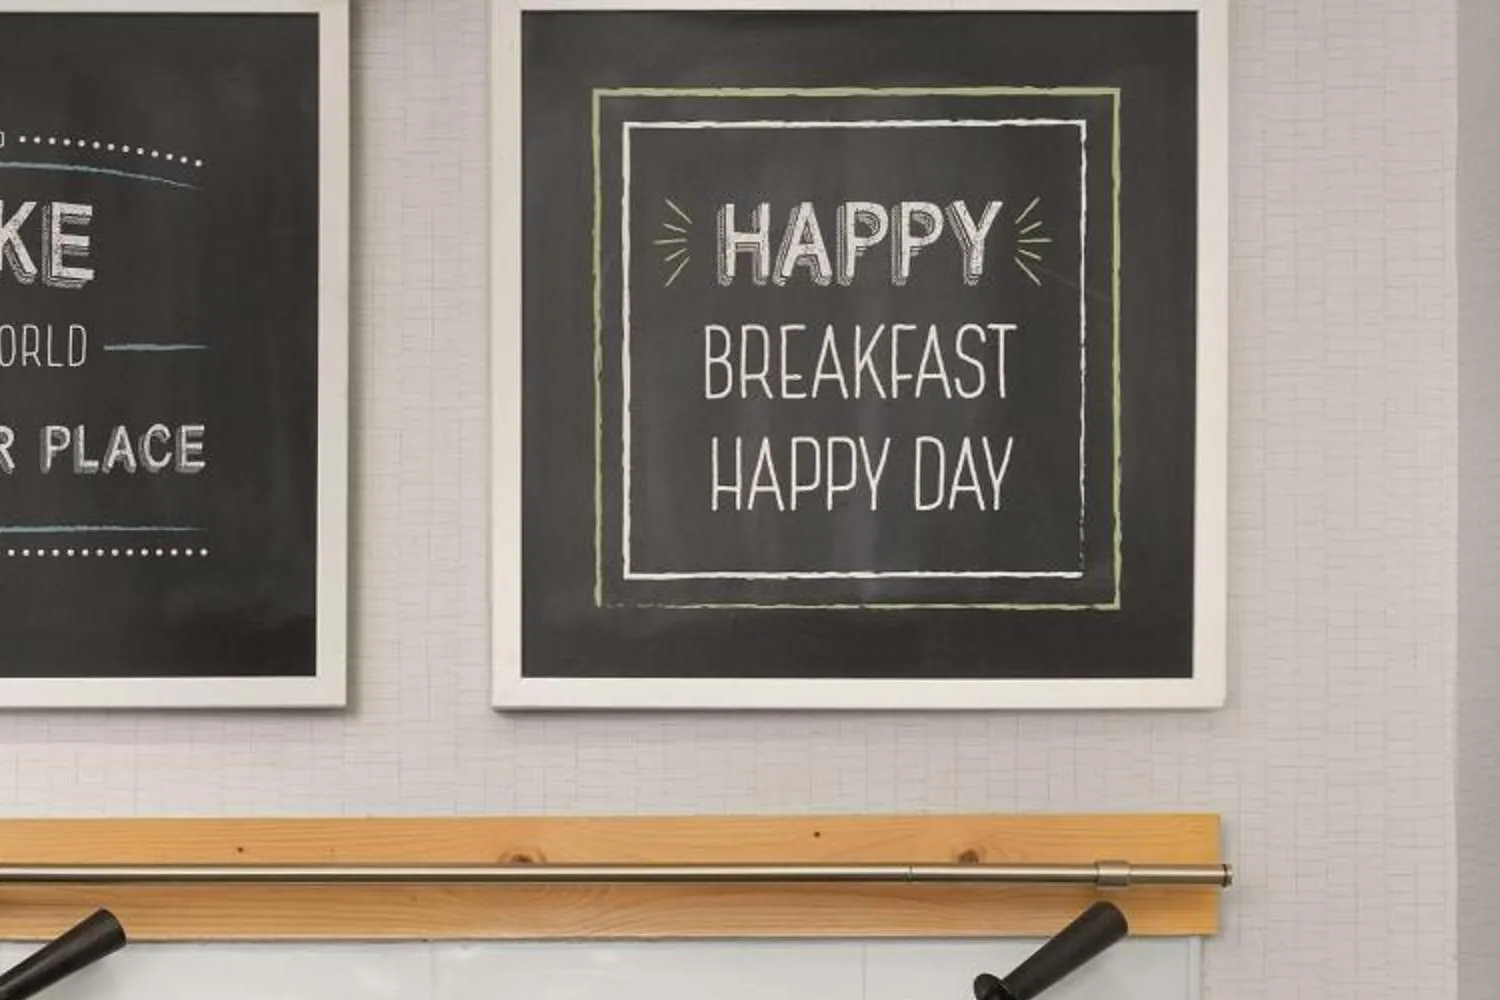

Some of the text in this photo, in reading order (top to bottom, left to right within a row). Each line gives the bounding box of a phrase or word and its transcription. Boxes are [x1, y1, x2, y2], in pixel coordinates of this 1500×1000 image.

[717, 200, 1003, 287] HAPPY
[704, 323, 1018, 400] BREAKFAST
[40, 423, 206, 476] PLACE
[711, 436, 1014, 512] HAPPY DAY
